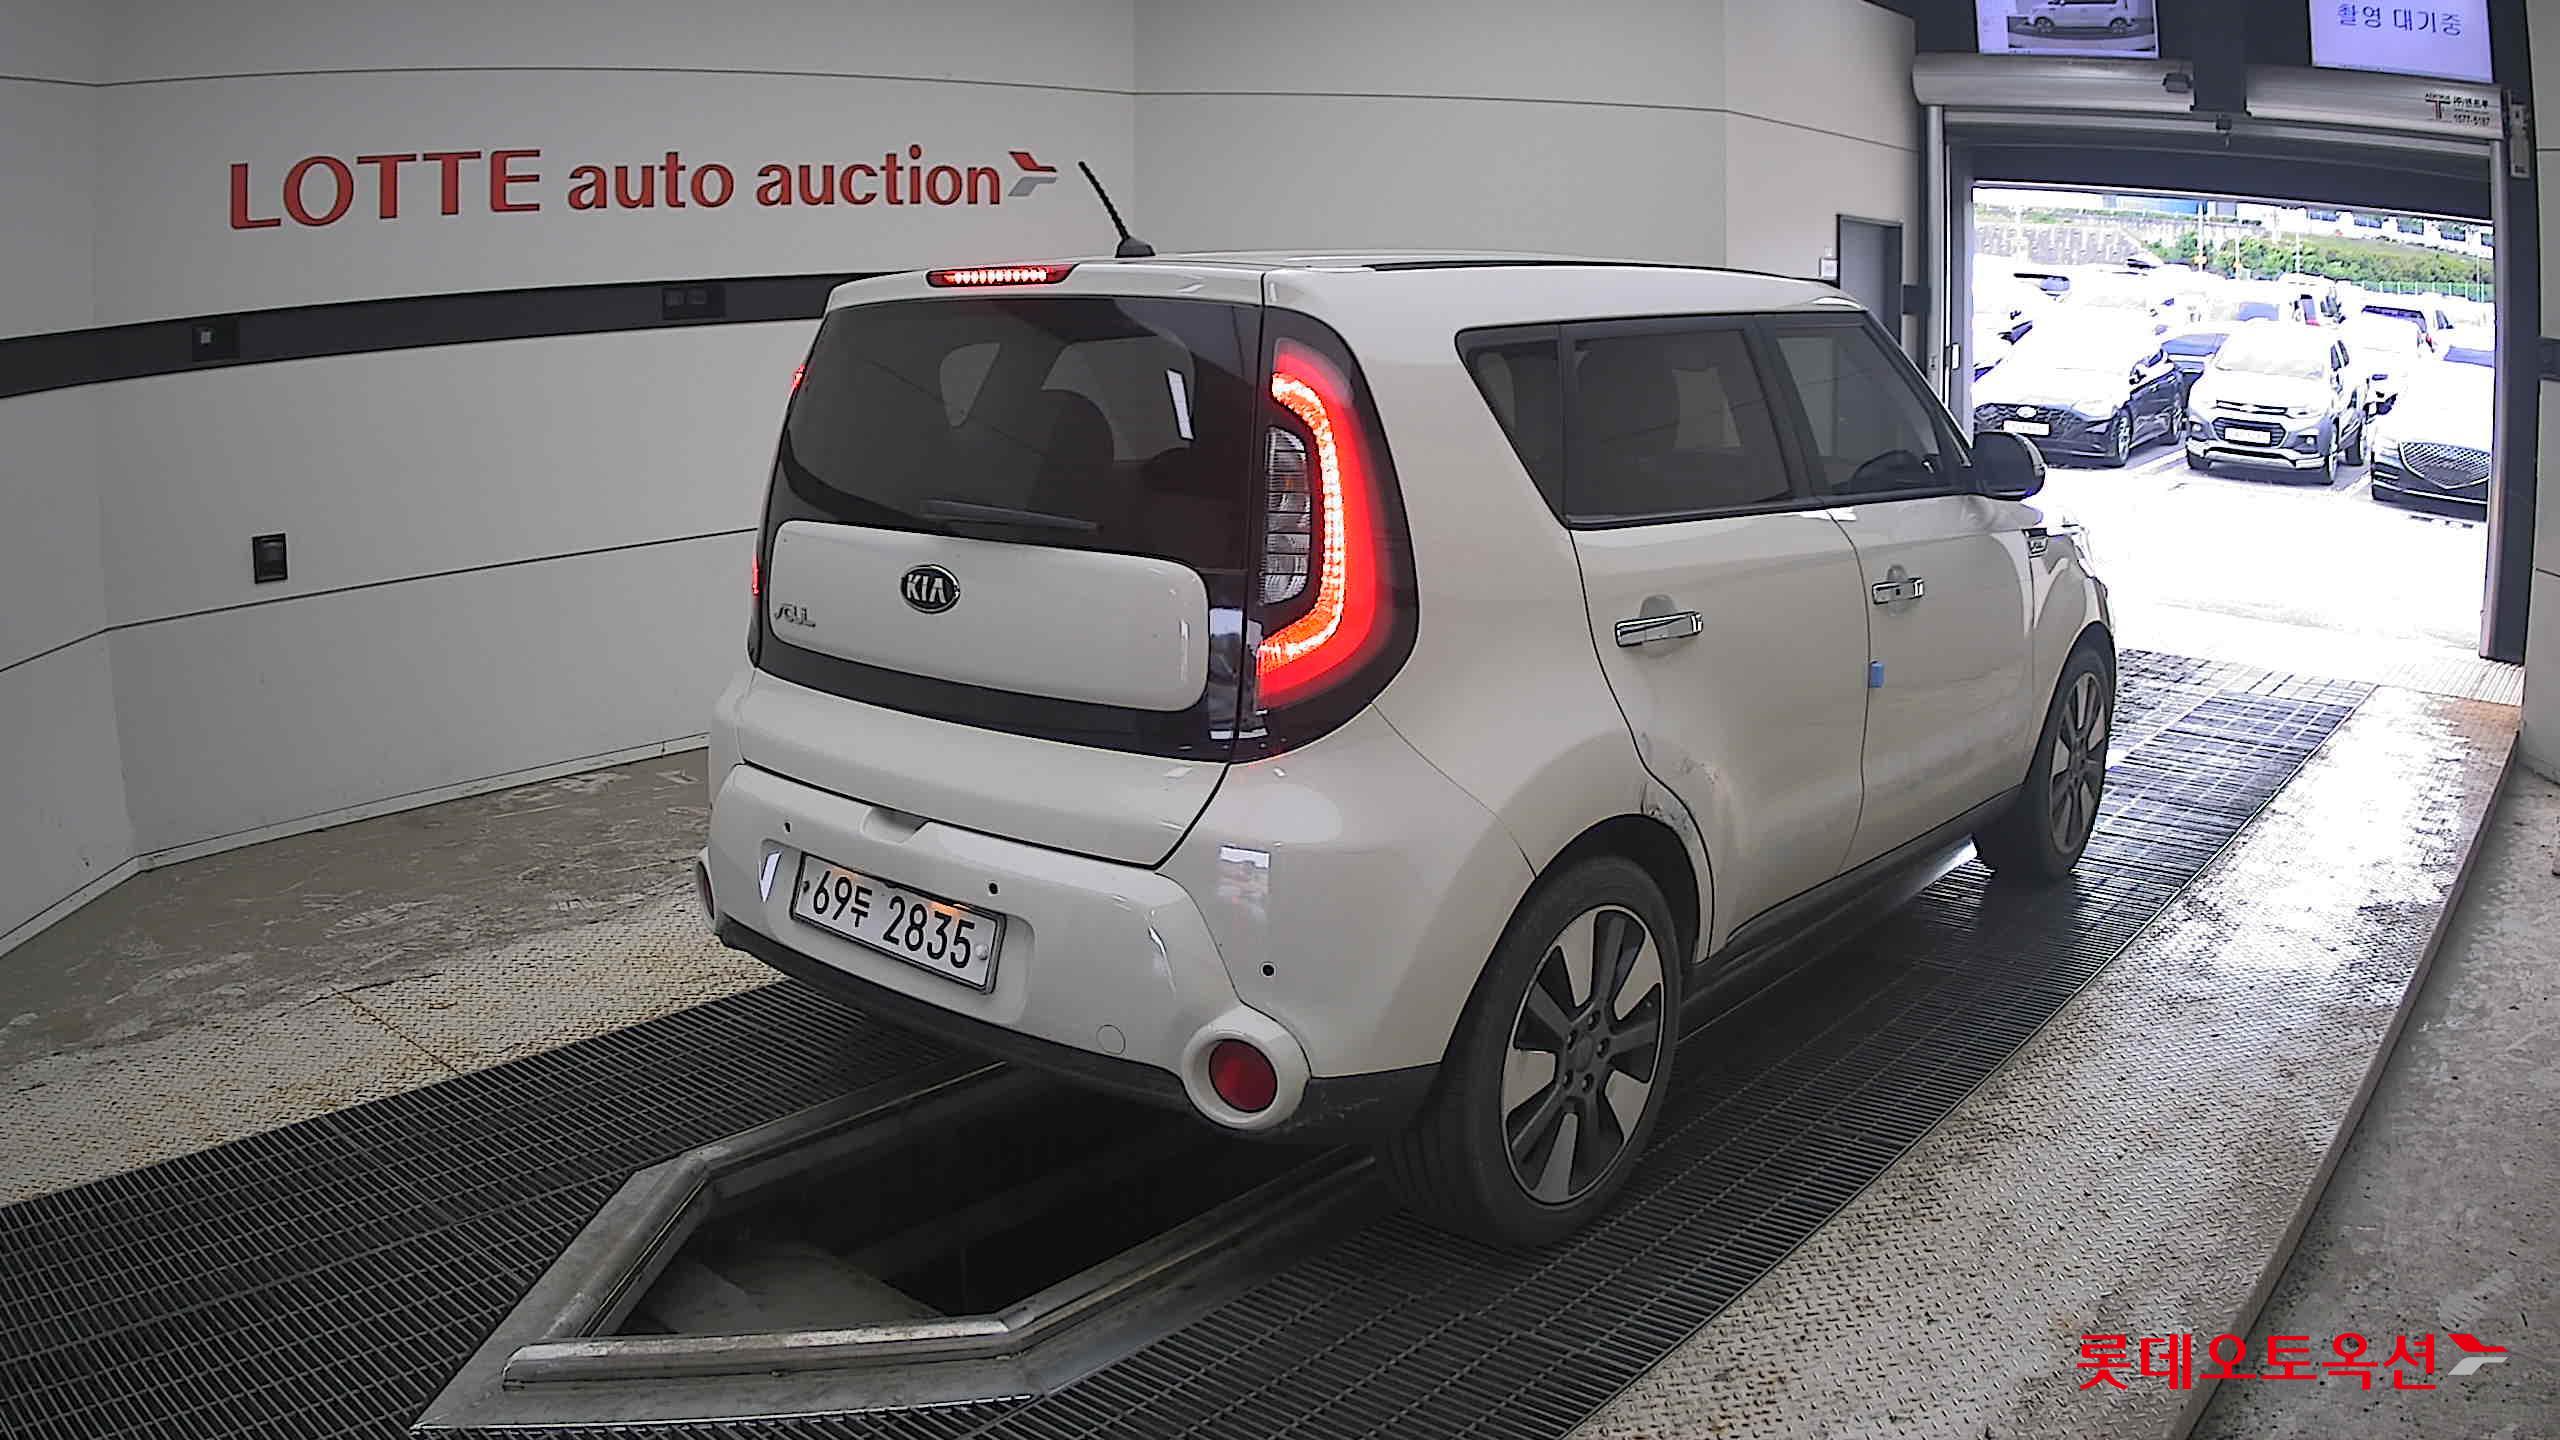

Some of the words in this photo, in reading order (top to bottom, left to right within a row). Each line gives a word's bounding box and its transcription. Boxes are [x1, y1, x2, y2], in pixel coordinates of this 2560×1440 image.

[2393, 8, 2462, 36] 대기중
[230, 149, 541, 230] LOTTE
[567, 150, 735, 209] auto
[756, 144, 1001, 206] auction
[906, 573, 947, 604] KIA
[813, 869, 873, 928] 69두
[882, 895, 976, 969] 2835
